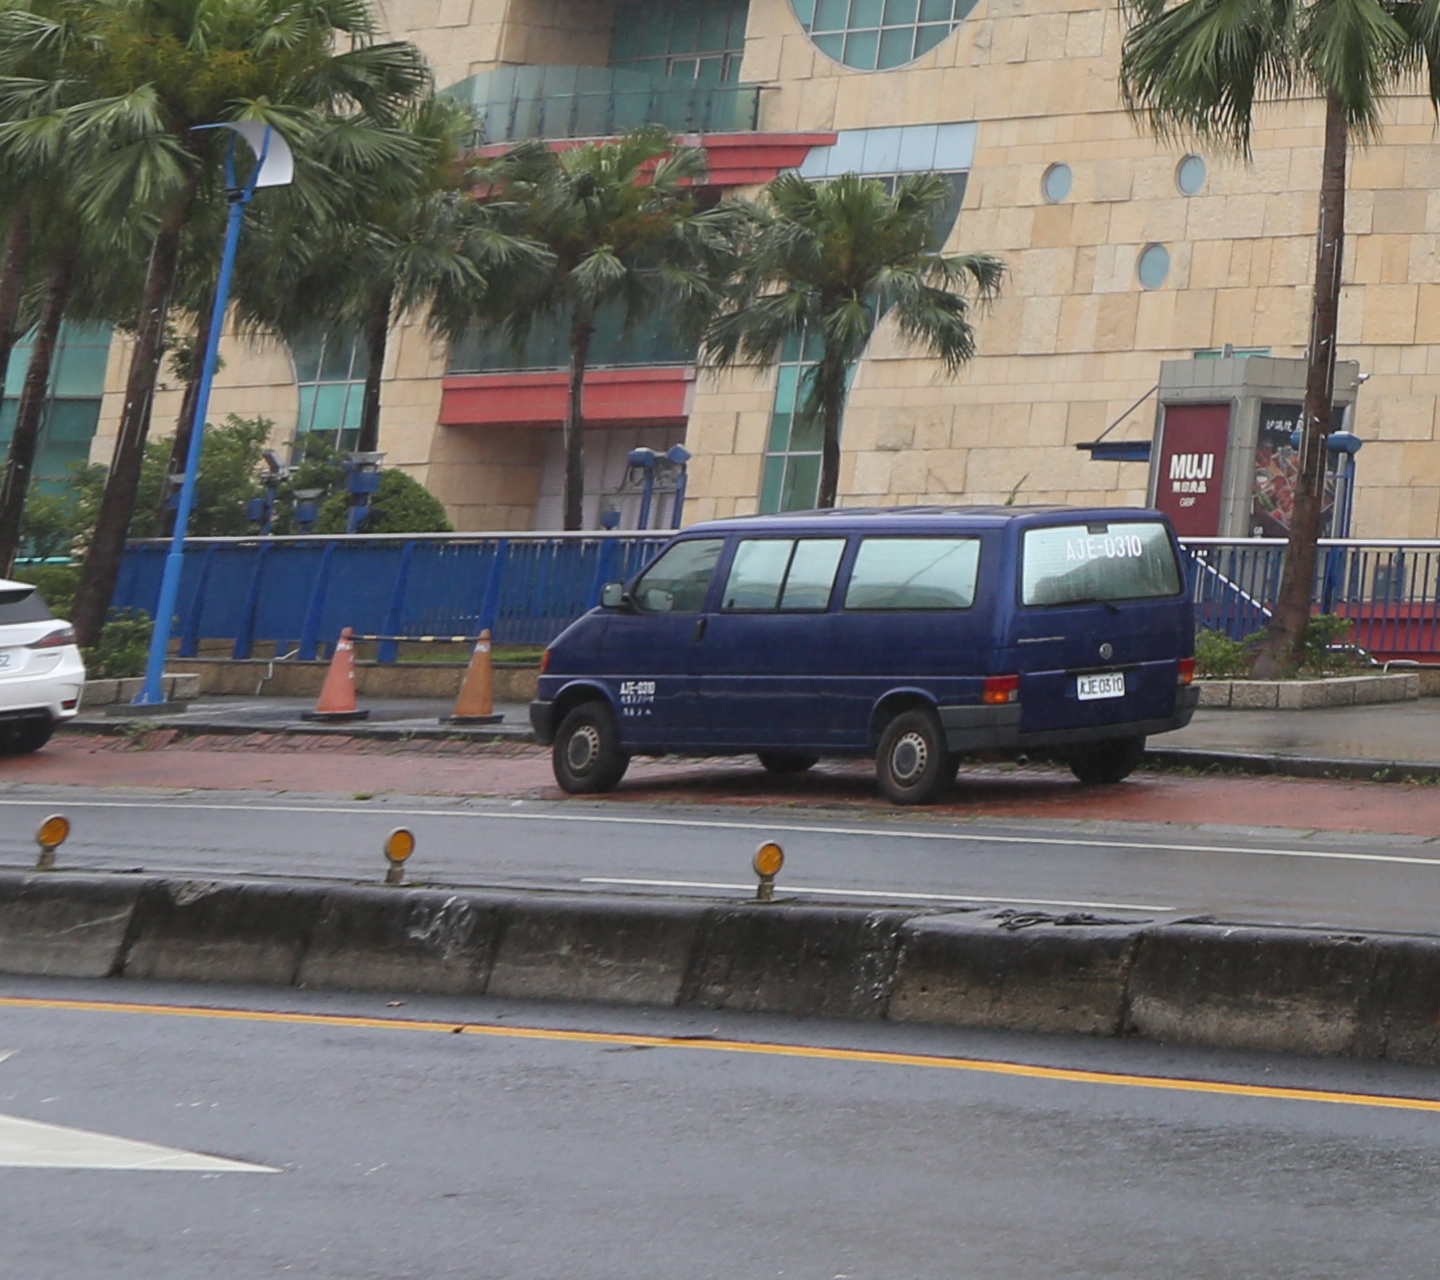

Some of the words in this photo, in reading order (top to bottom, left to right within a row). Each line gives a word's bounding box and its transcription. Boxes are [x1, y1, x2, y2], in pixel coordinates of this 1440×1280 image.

[1168, 453, 1215, 480] MUJI
[1066, 535, 1143, 561] AJE-0310
[1079, 676, 1125, 696] AJE-0310
